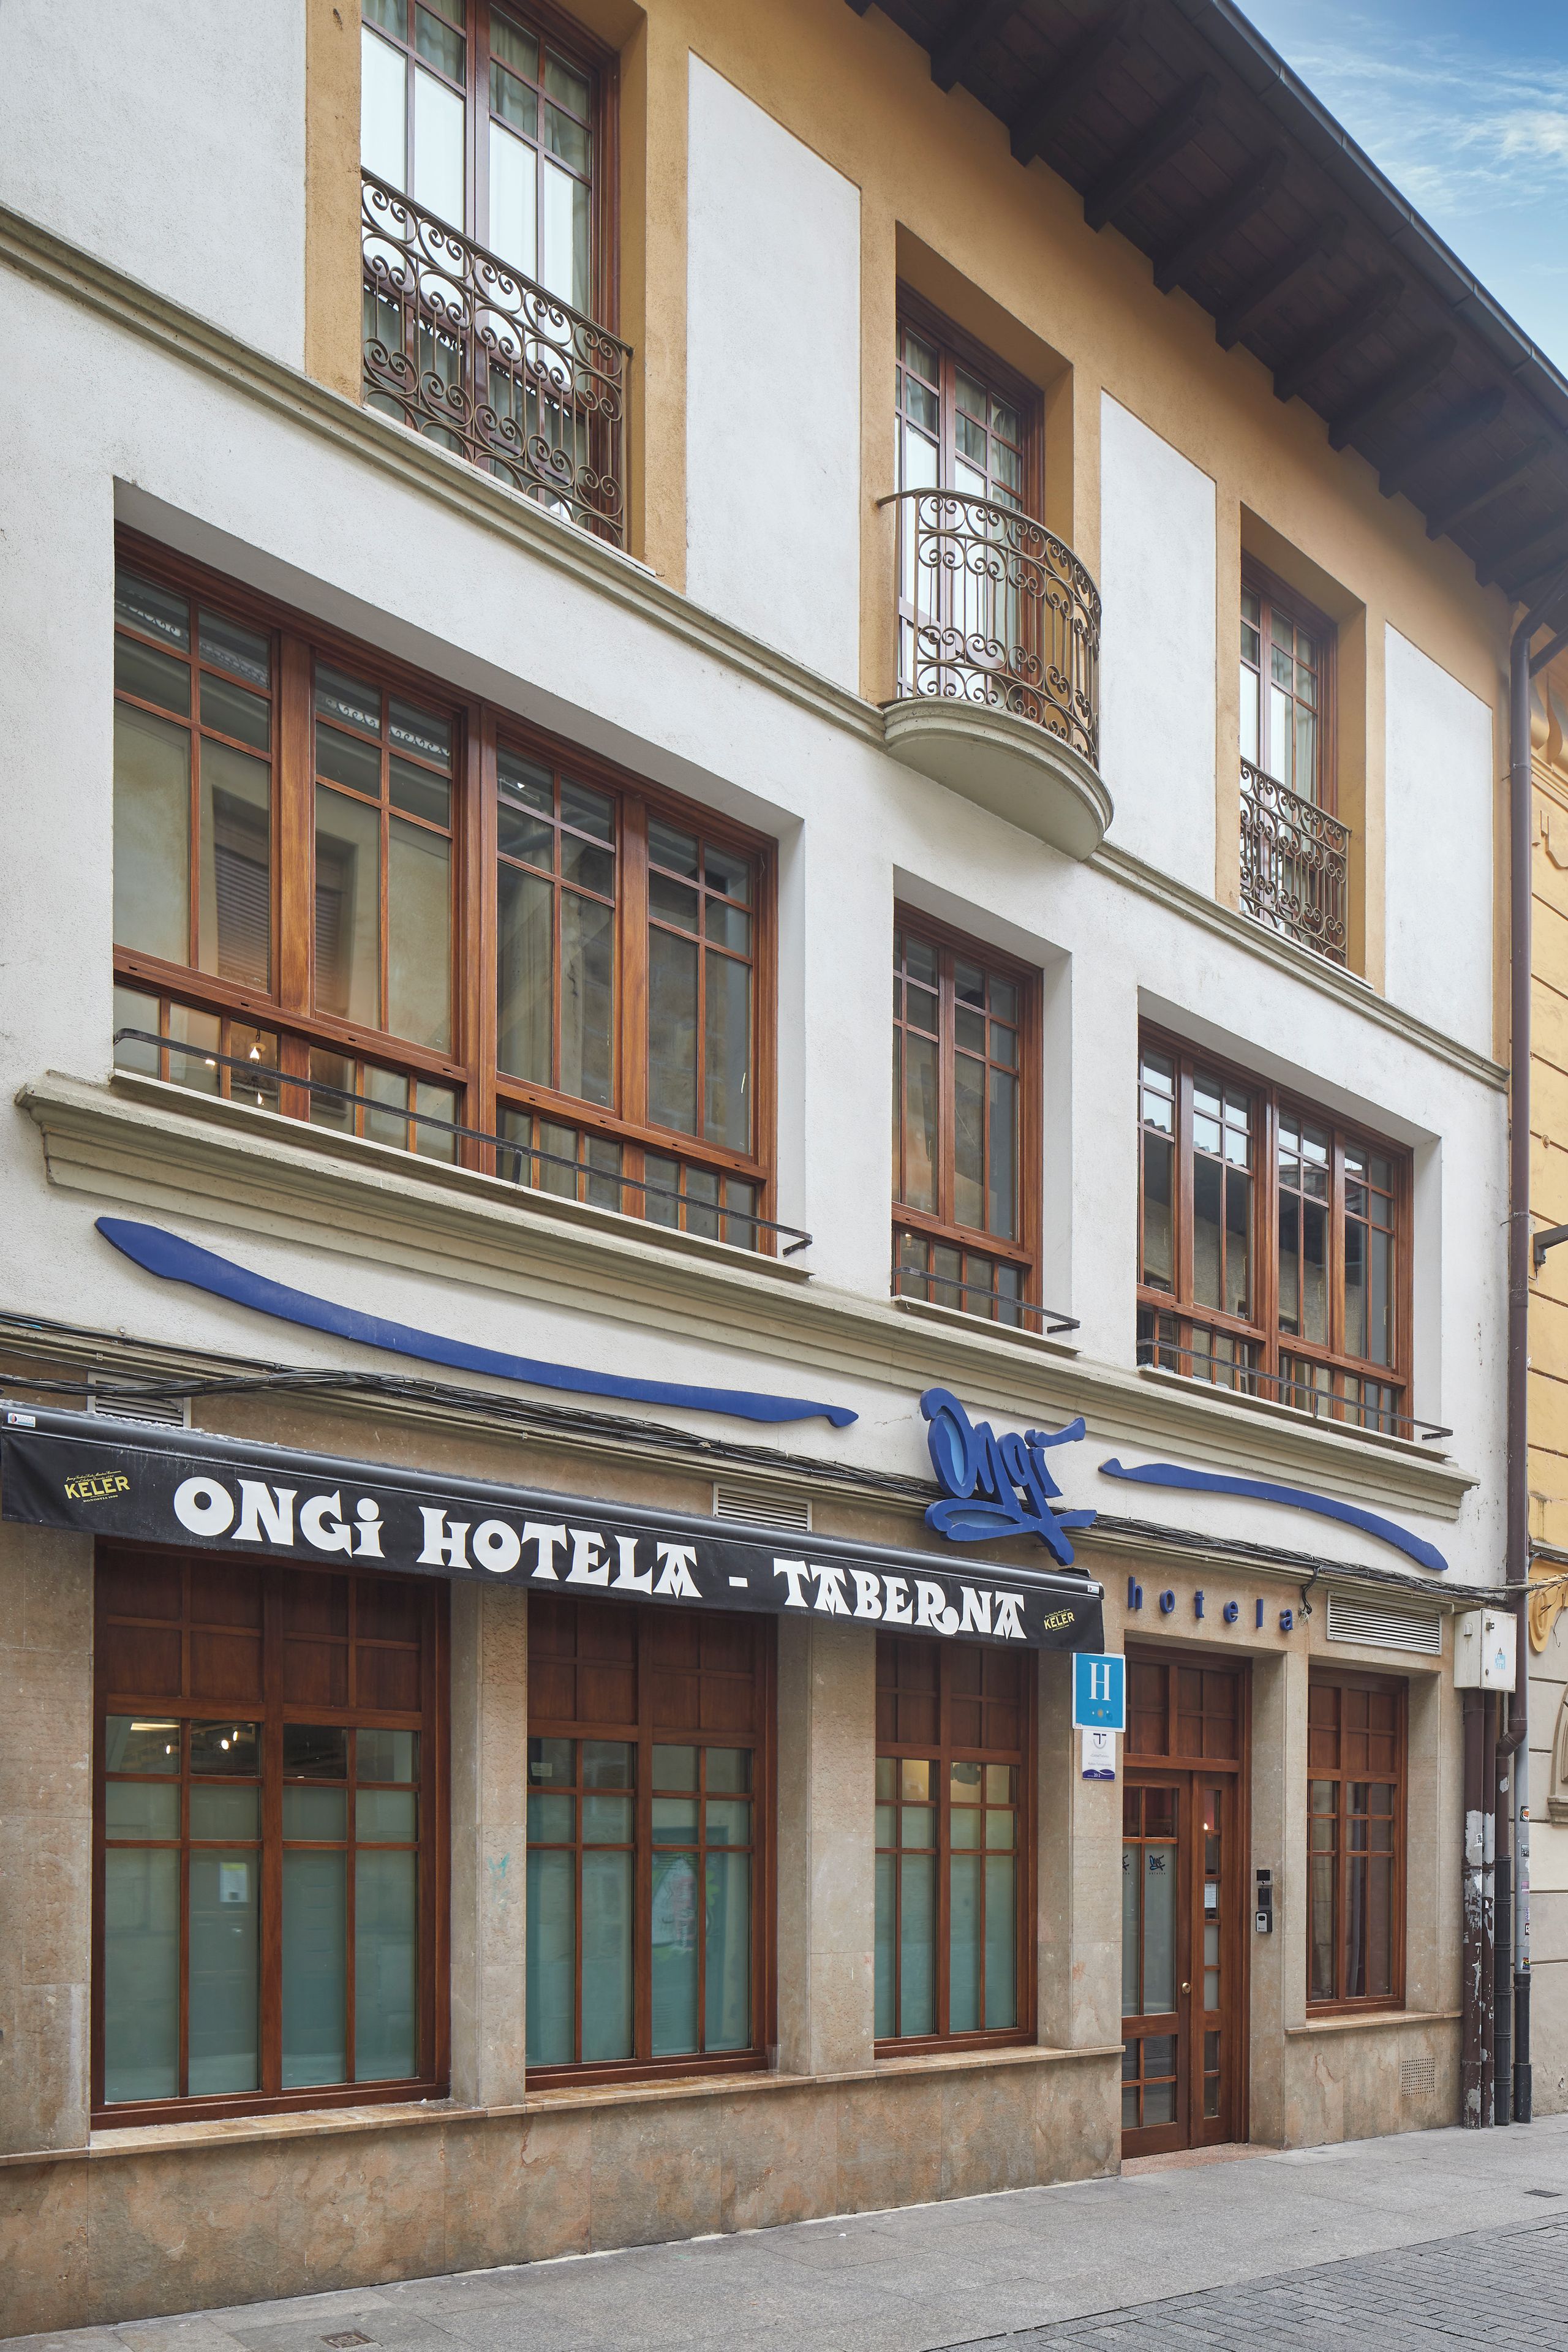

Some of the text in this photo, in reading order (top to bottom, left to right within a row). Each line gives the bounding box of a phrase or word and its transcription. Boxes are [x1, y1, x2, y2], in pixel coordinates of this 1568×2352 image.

[64, 1476, 130, 1499] KELER
[416, 1506, 703, 1599] HOTELA
[773, 1558, 1027, 1640] TABERNA
[1044, 1611, 1075, 1630] KELER
[1128, 1576, 1294, 1631] hotela
[1088, 1662, 1112, 1702] H
